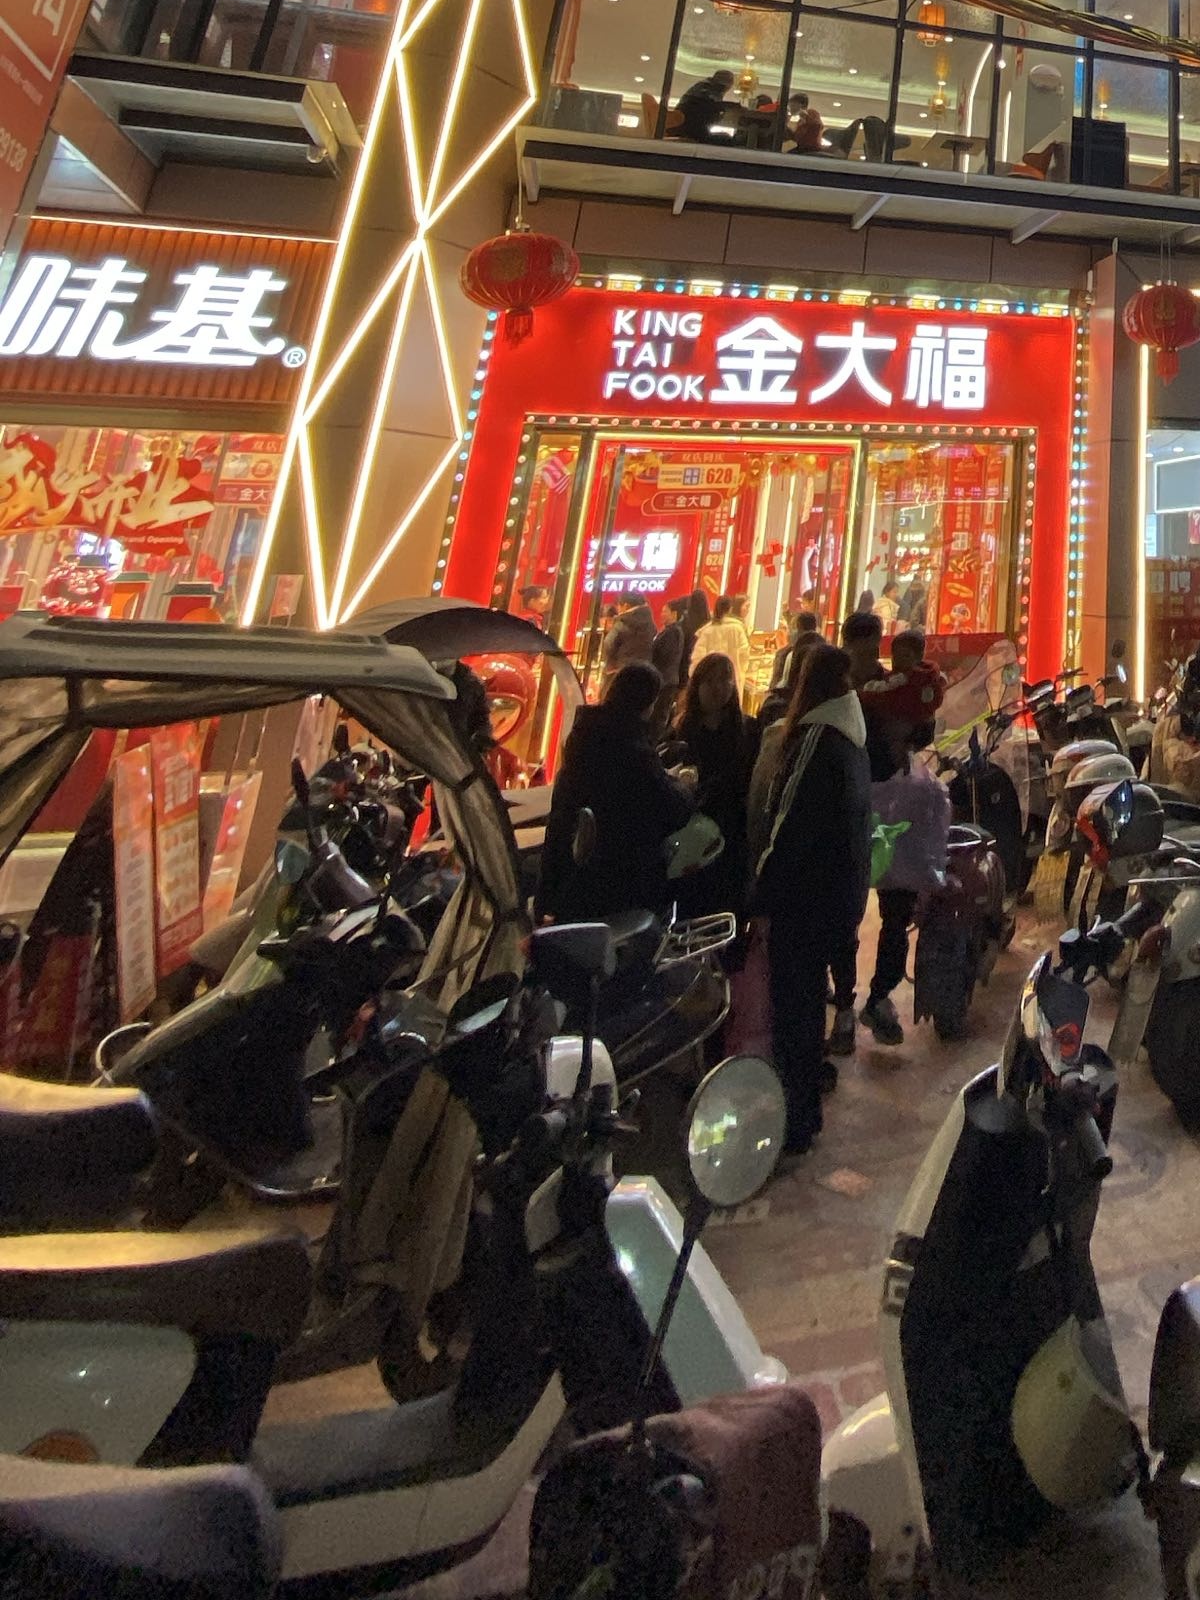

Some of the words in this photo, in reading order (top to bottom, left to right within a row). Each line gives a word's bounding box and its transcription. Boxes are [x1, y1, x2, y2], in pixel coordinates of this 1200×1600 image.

[0, 254, 286, 368] 味基
[613, 308, 704, 339] KING
[612, 340, 673, 368] TAI
[709, 316, 989, 410] 金大福
[603, 372, 704, 401] FOOK
[705, 467, 734, 485] 628
[628, 580, 667, 592] FOOK
